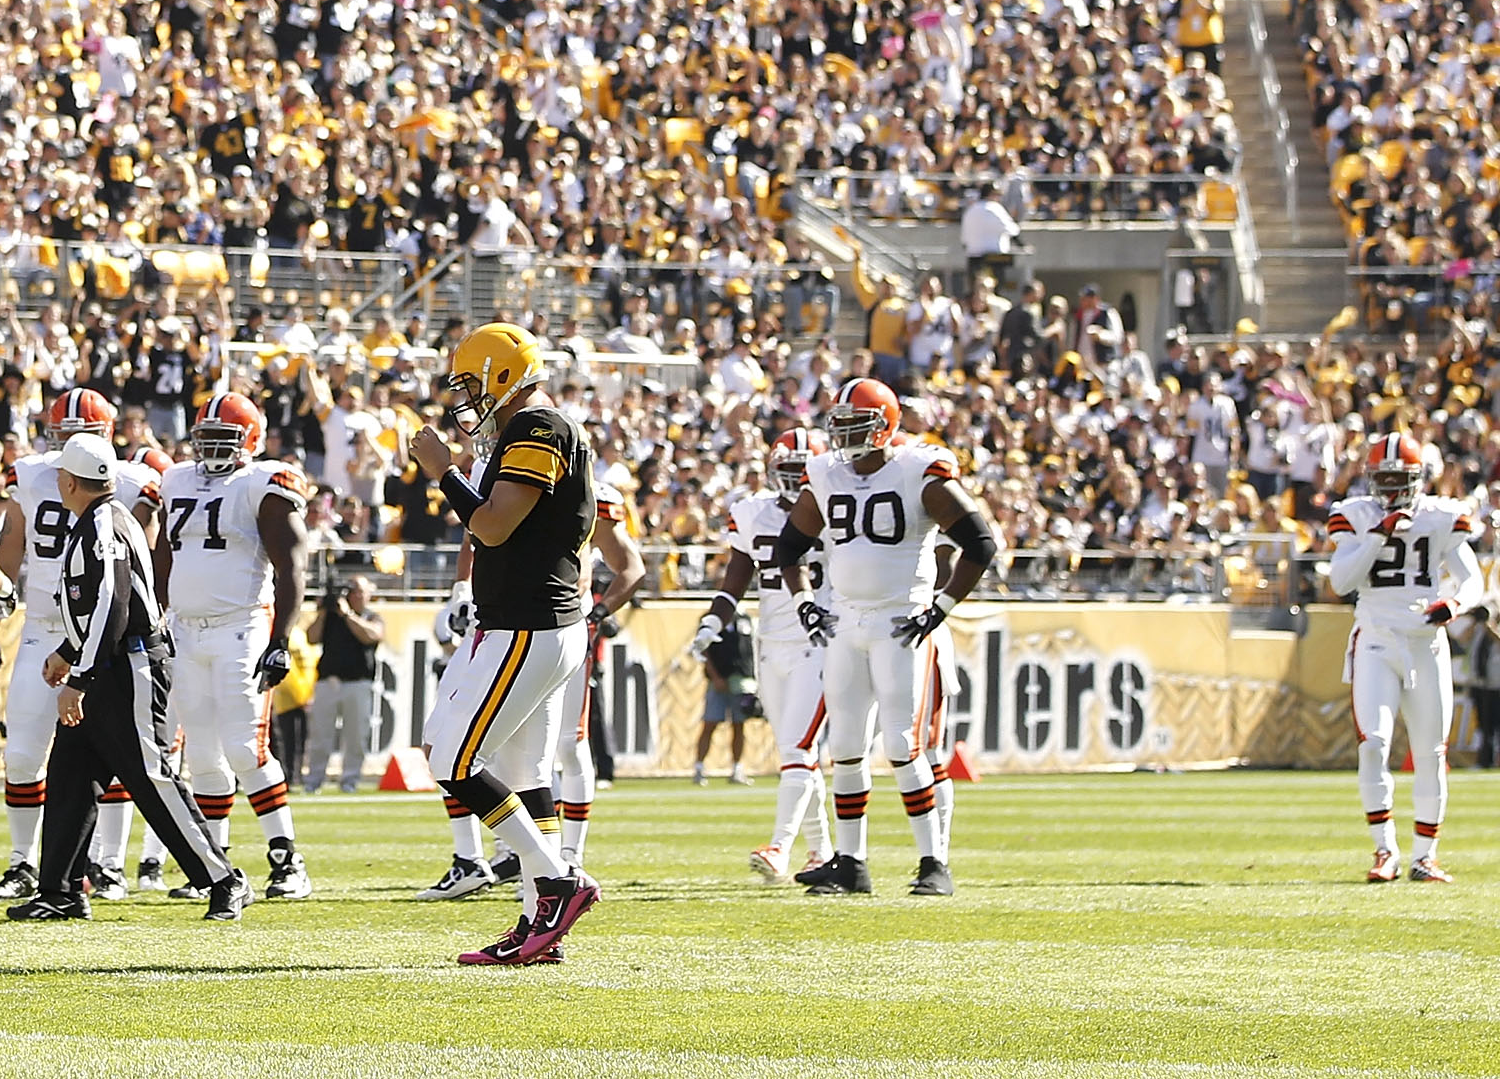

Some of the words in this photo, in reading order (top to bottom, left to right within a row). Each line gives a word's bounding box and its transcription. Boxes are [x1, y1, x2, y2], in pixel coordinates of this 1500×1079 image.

[361, 203, 378, 230] 7
[32, 499, 72, 559] 9
[169, 496, 227, 552] 71
[827, 490, 906, 546] 90
[1369, 535, 1432, 588] 21
